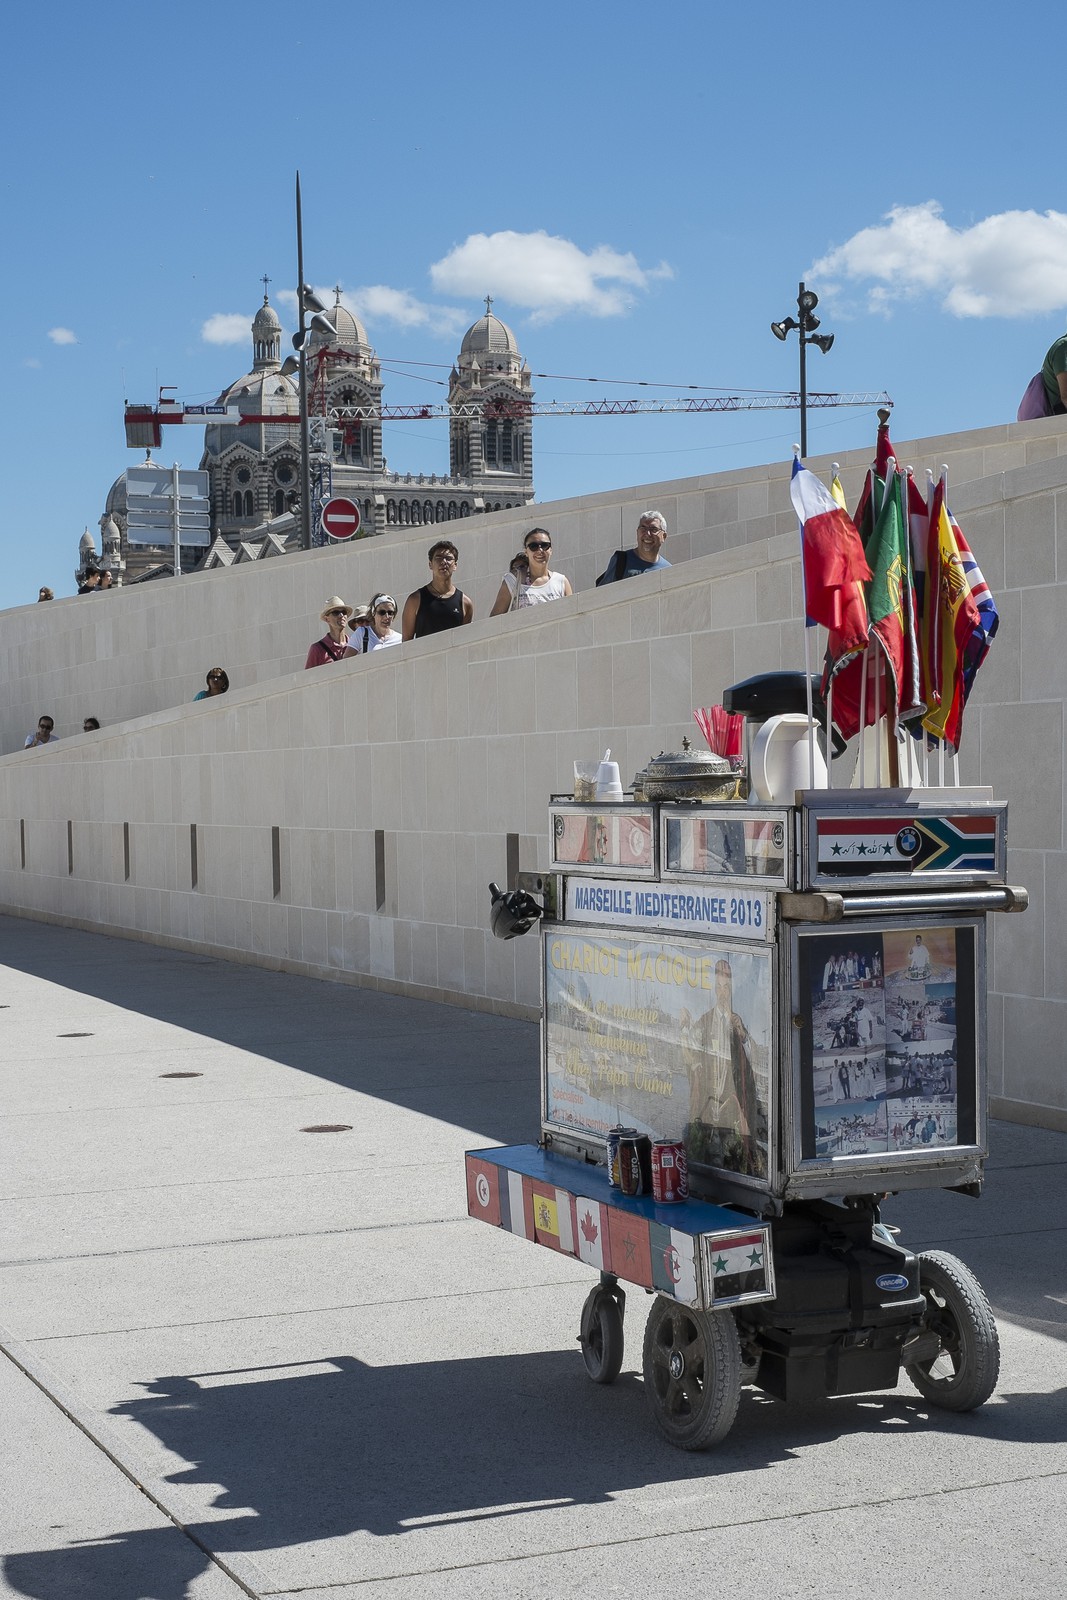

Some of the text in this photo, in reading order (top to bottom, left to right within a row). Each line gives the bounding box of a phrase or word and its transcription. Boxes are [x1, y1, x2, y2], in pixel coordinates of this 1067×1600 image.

[899, 829, 916, 838] BMW
[575, 887, 762, 927] MARSEILLE MEDITERRANEE 2013
[551, 940, 713, 991] CHARIOT MAGIQUE
